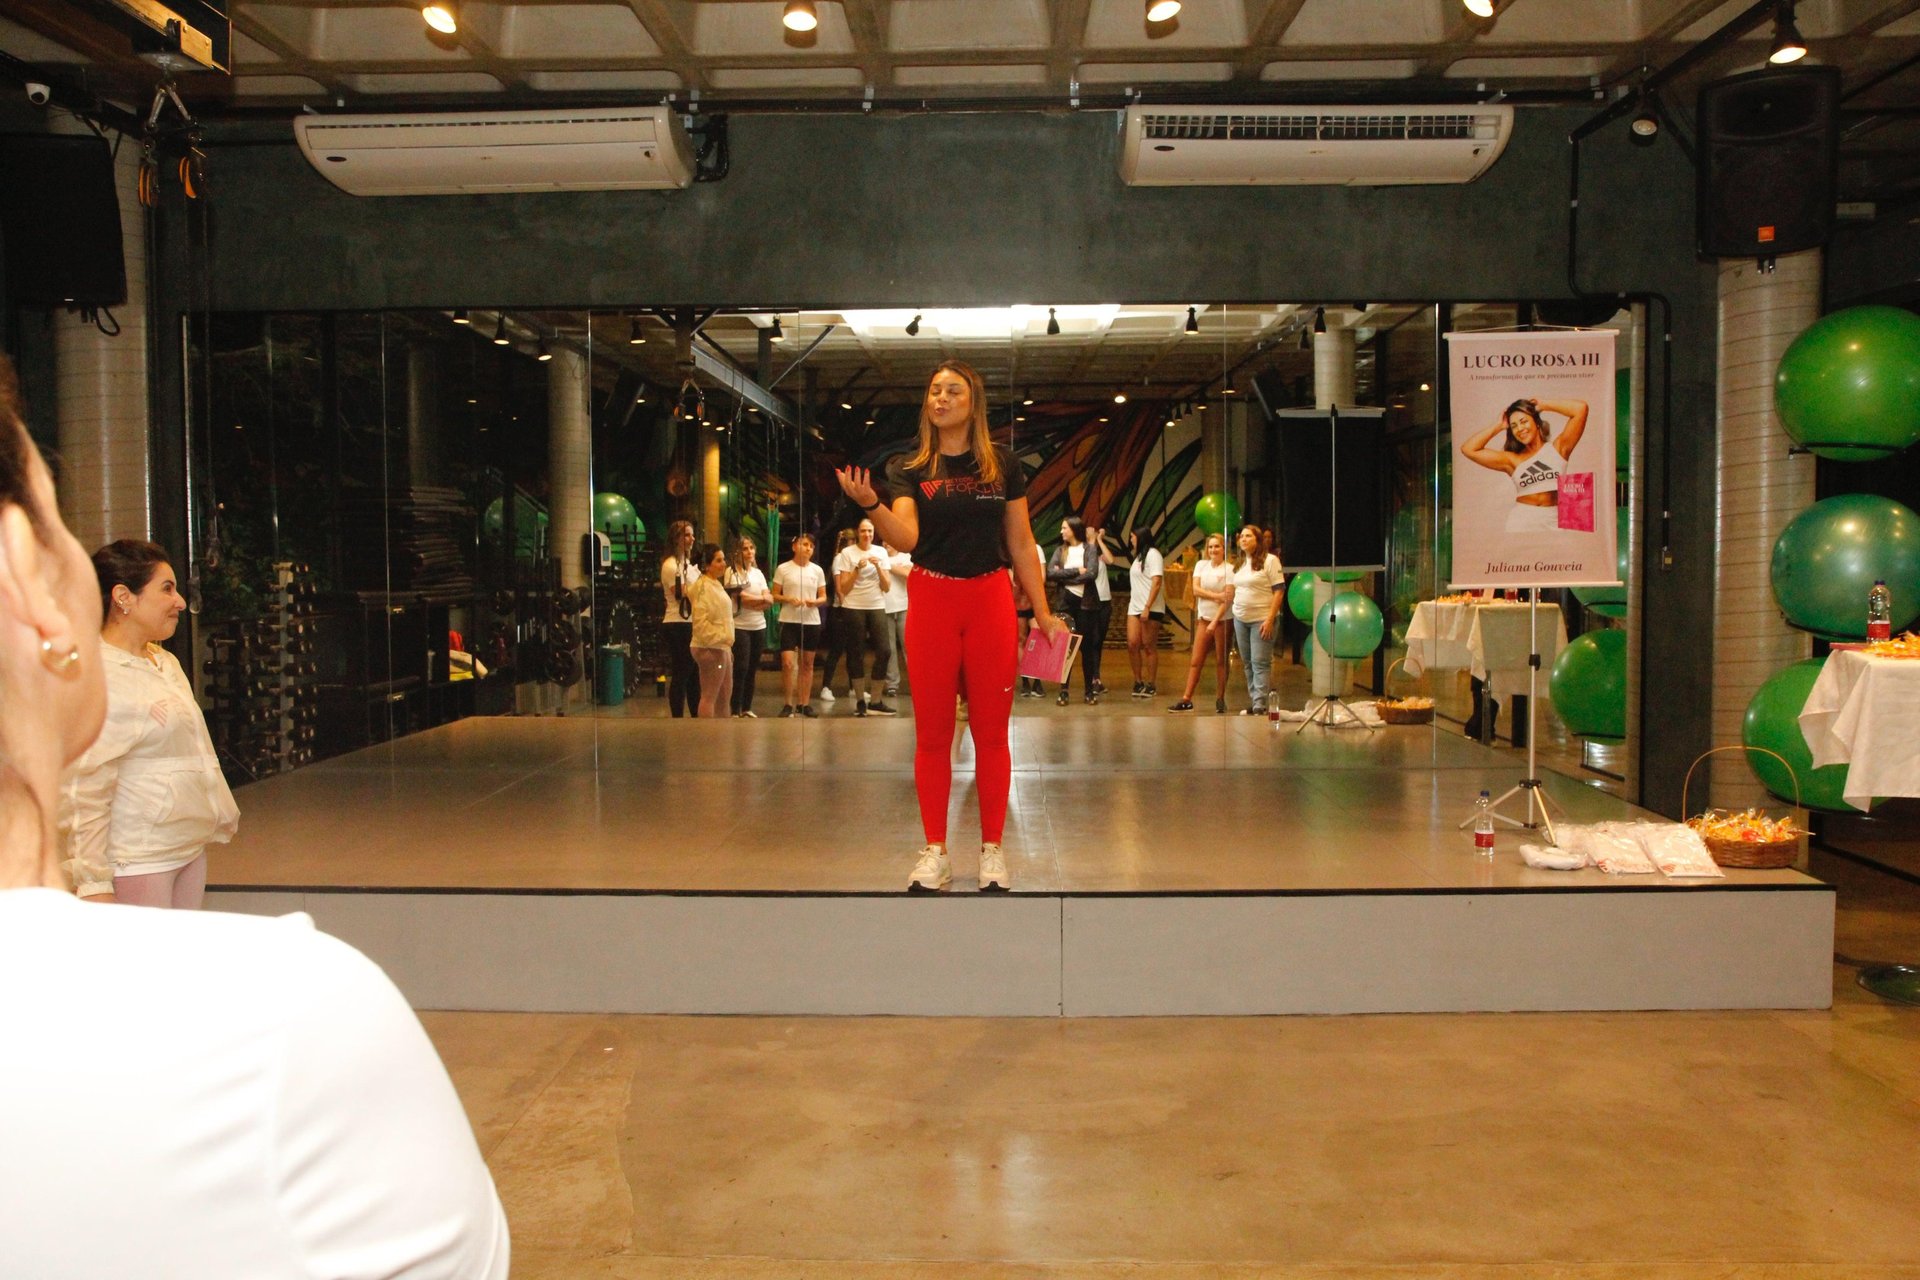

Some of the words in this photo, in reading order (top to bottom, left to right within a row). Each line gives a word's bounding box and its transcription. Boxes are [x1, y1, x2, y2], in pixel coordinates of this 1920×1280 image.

[1463, 354, 1526, 368] LUCRO
[1581, 352, 1600, 366] III
[1520, 471, 1560, 488] adidas
[1485, 562, 1530, 574] Juliana
[1534, 561, 1583, 571] Gouveia
